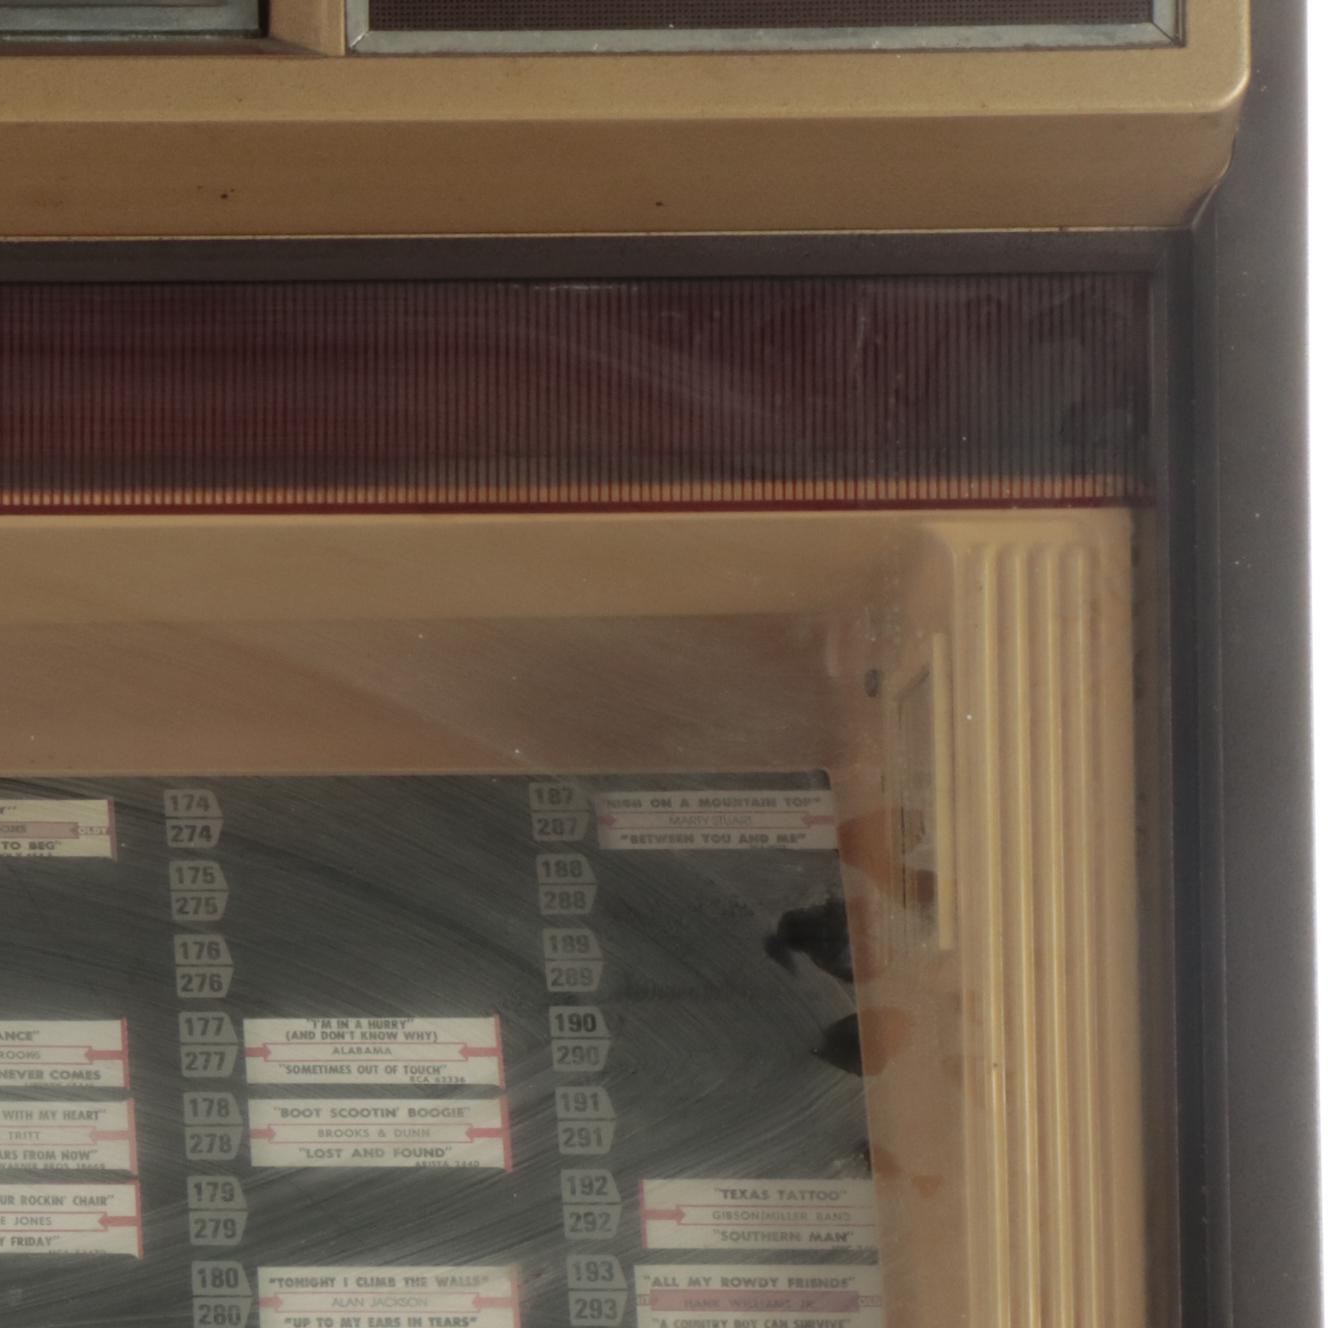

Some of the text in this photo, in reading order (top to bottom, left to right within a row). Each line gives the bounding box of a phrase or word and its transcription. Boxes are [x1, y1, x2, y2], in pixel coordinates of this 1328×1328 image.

[185, 1053, 225, 1071] 277
[566, 1177, 608, 1195] 192
[14, 1216, 53, 1226] JONES
